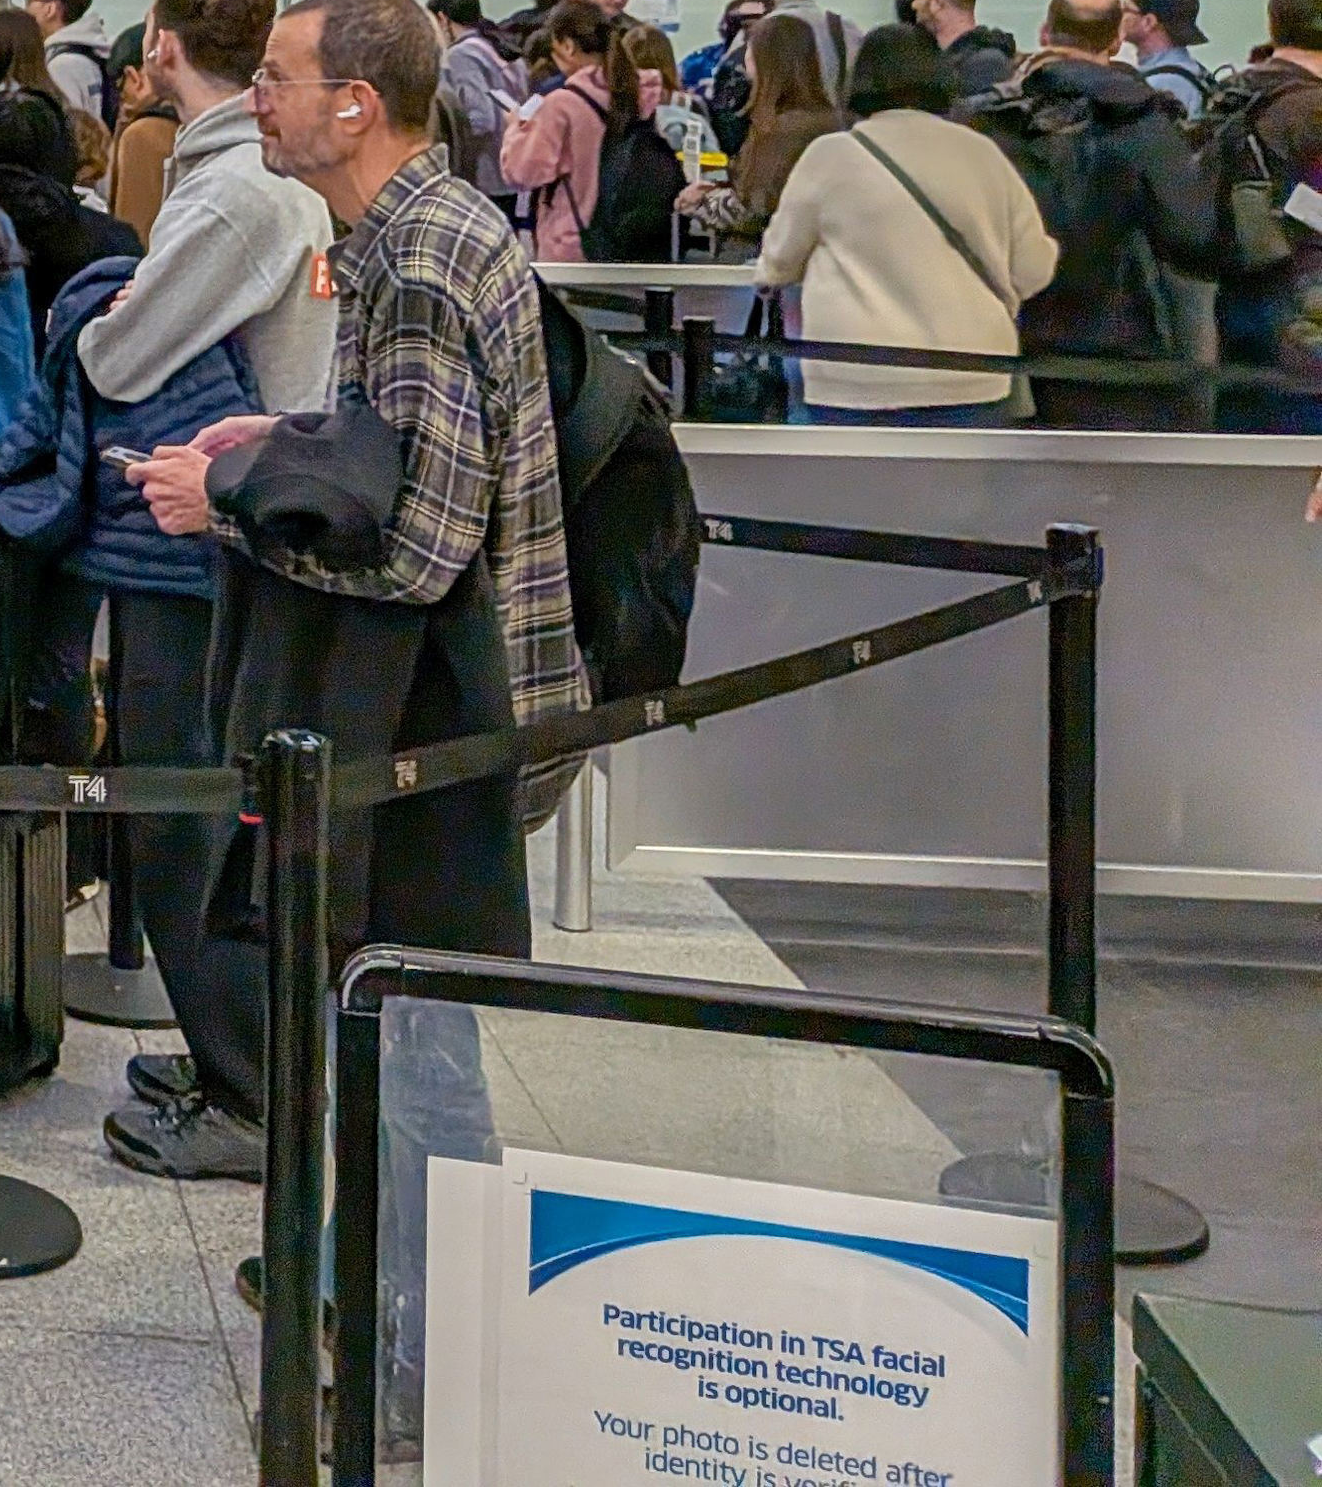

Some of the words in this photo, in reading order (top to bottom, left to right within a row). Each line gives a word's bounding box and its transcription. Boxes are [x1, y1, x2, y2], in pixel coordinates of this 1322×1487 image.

[704, 518, 733, 541] T4
[68, 775, 107, 803] T4
[603, 1303, 773, 1350] Participation
[781, 1330, 805, 1356] in
[811, 1335, 865, 1365] TSA
[872, 1344, 945, 1377] facial
[617, 1338, 768, 1379] recognition
[775, 1359, 929, 1408] technology
[698, 1375, 718, 1400] is
[725, 1385, 844, 1421] optional.
[594, 1410, 655, 1441] Your
[663, 1424, 739, 1456] photo
[749, 1435, 769, 1461] is
[777, 1442, 877, 1478] deleted
[886, 1462, 954, 1487] after
[645, 1447, 746, 1487] identity
[757, 1466, 776, 1487] is
